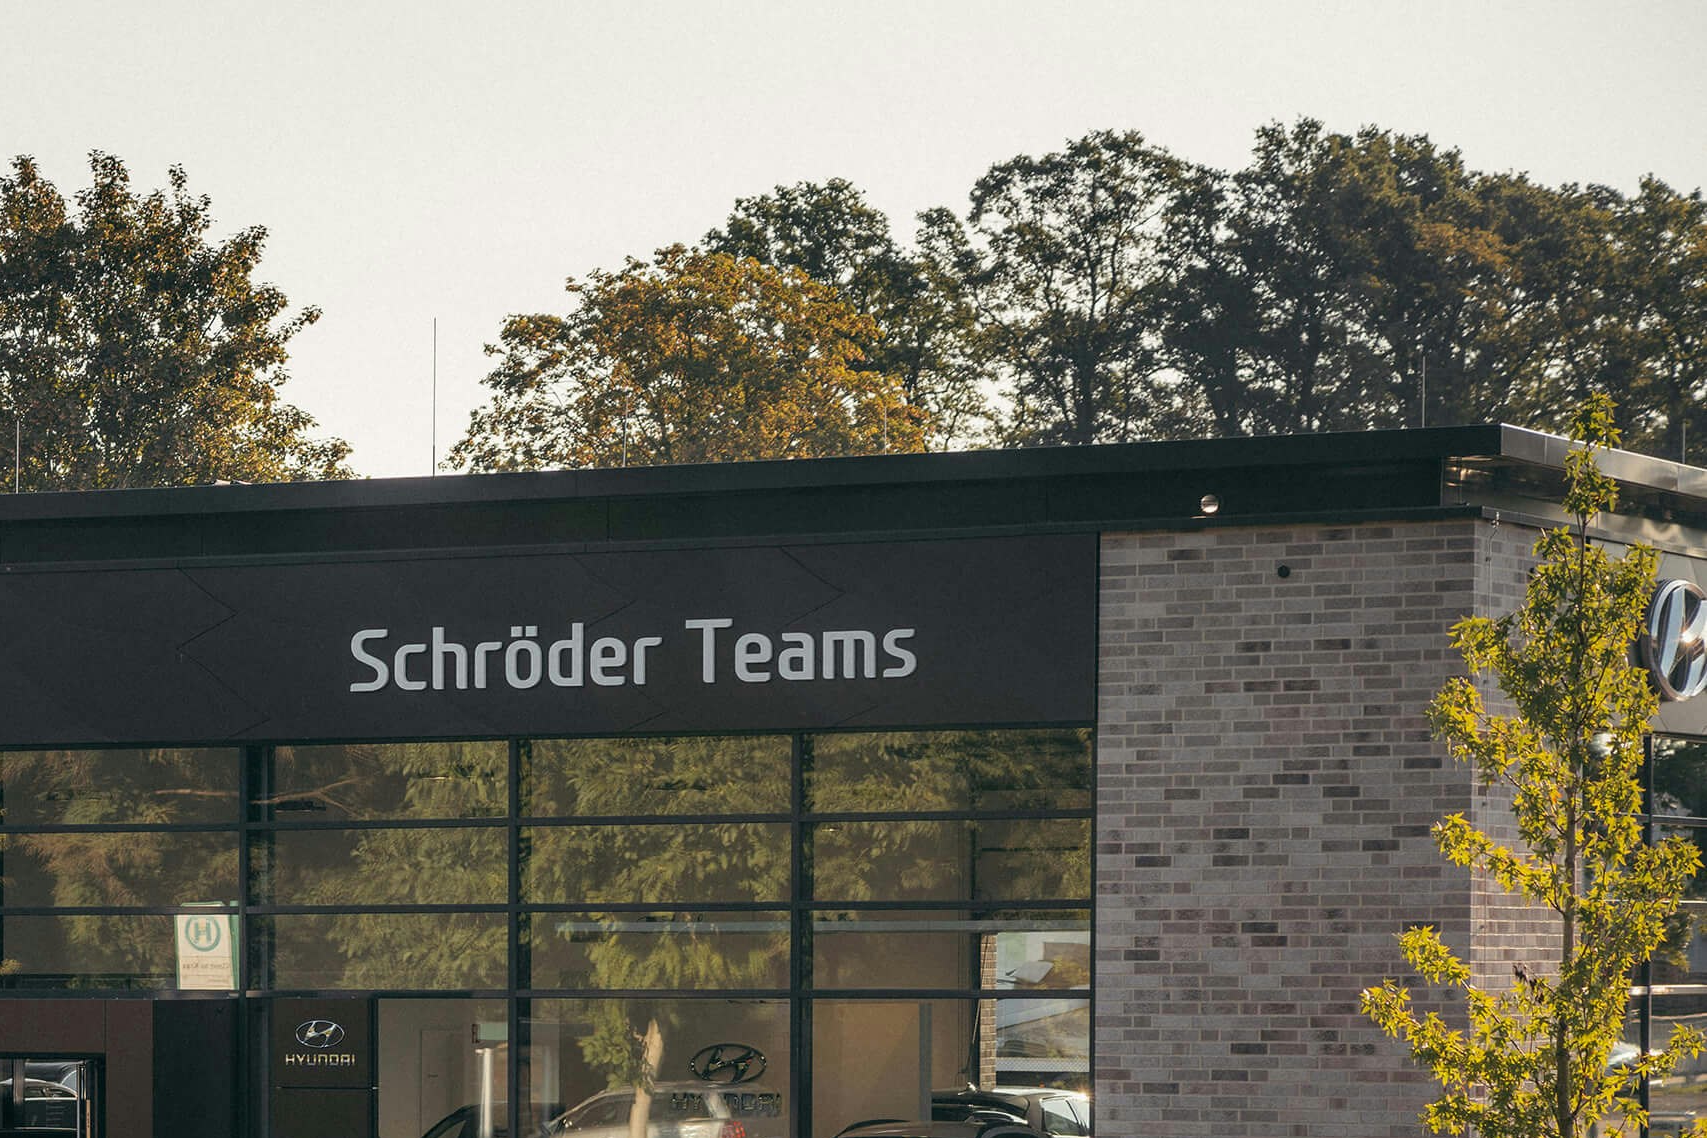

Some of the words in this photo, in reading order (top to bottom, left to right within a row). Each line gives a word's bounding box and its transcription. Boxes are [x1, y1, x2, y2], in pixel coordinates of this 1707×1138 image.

[349, 622, 663, 693] Schröder
[685, 618, 918, 684] Teams
[285, 1053, 356, 1066] HYUNDAI
